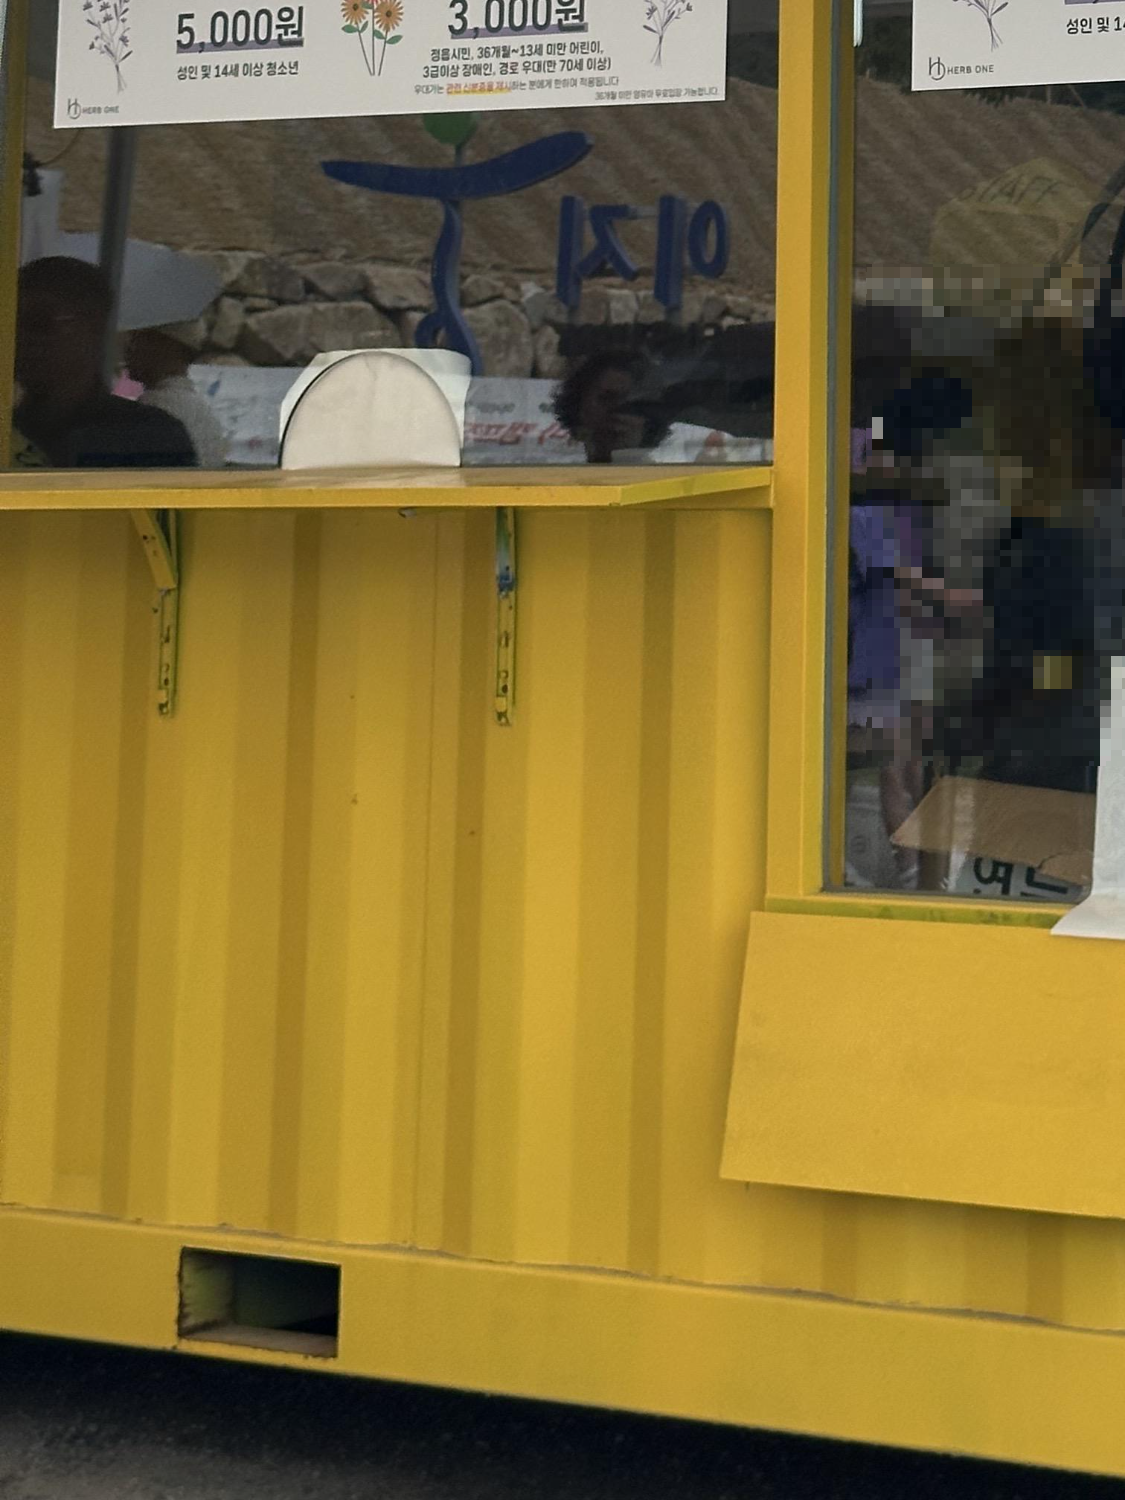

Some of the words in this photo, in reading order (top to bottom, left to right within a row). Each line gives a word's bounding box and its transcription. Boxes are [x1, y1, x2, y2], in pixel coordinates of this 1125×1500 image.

[176, 6, 304, 53] 5,000원
[1066, 18, 1092, 34] 성인
[1097, 16, 1109, 32] 및
[430, 48, 474, 63] 정읍시민,
[477, 43, 543, 60] 36개월~13세
[546, 42, 567, 57] 미만
[569, 40, 604, 56] 어린이,
[177, 65, 198, 81] 성인
[201, 64, 211, 80] 및
[214, 63, 239, 78] 14세
[242, 62, 264, 77] 이상
[266, 60, 299, 77] 청소년
[423, 64, 459, 79] 3급이상
[461, 62, 496, 78] 장애인,
[499, 60, 519, 75] 경로
[522, 58, 558, 74] 우대(만
[560, 56, 584, 73] 70세
[586, 56, 612, 72] 이상)
[947, 66, 972, 75] HERB
[975, 64, 994, 73] ONE
